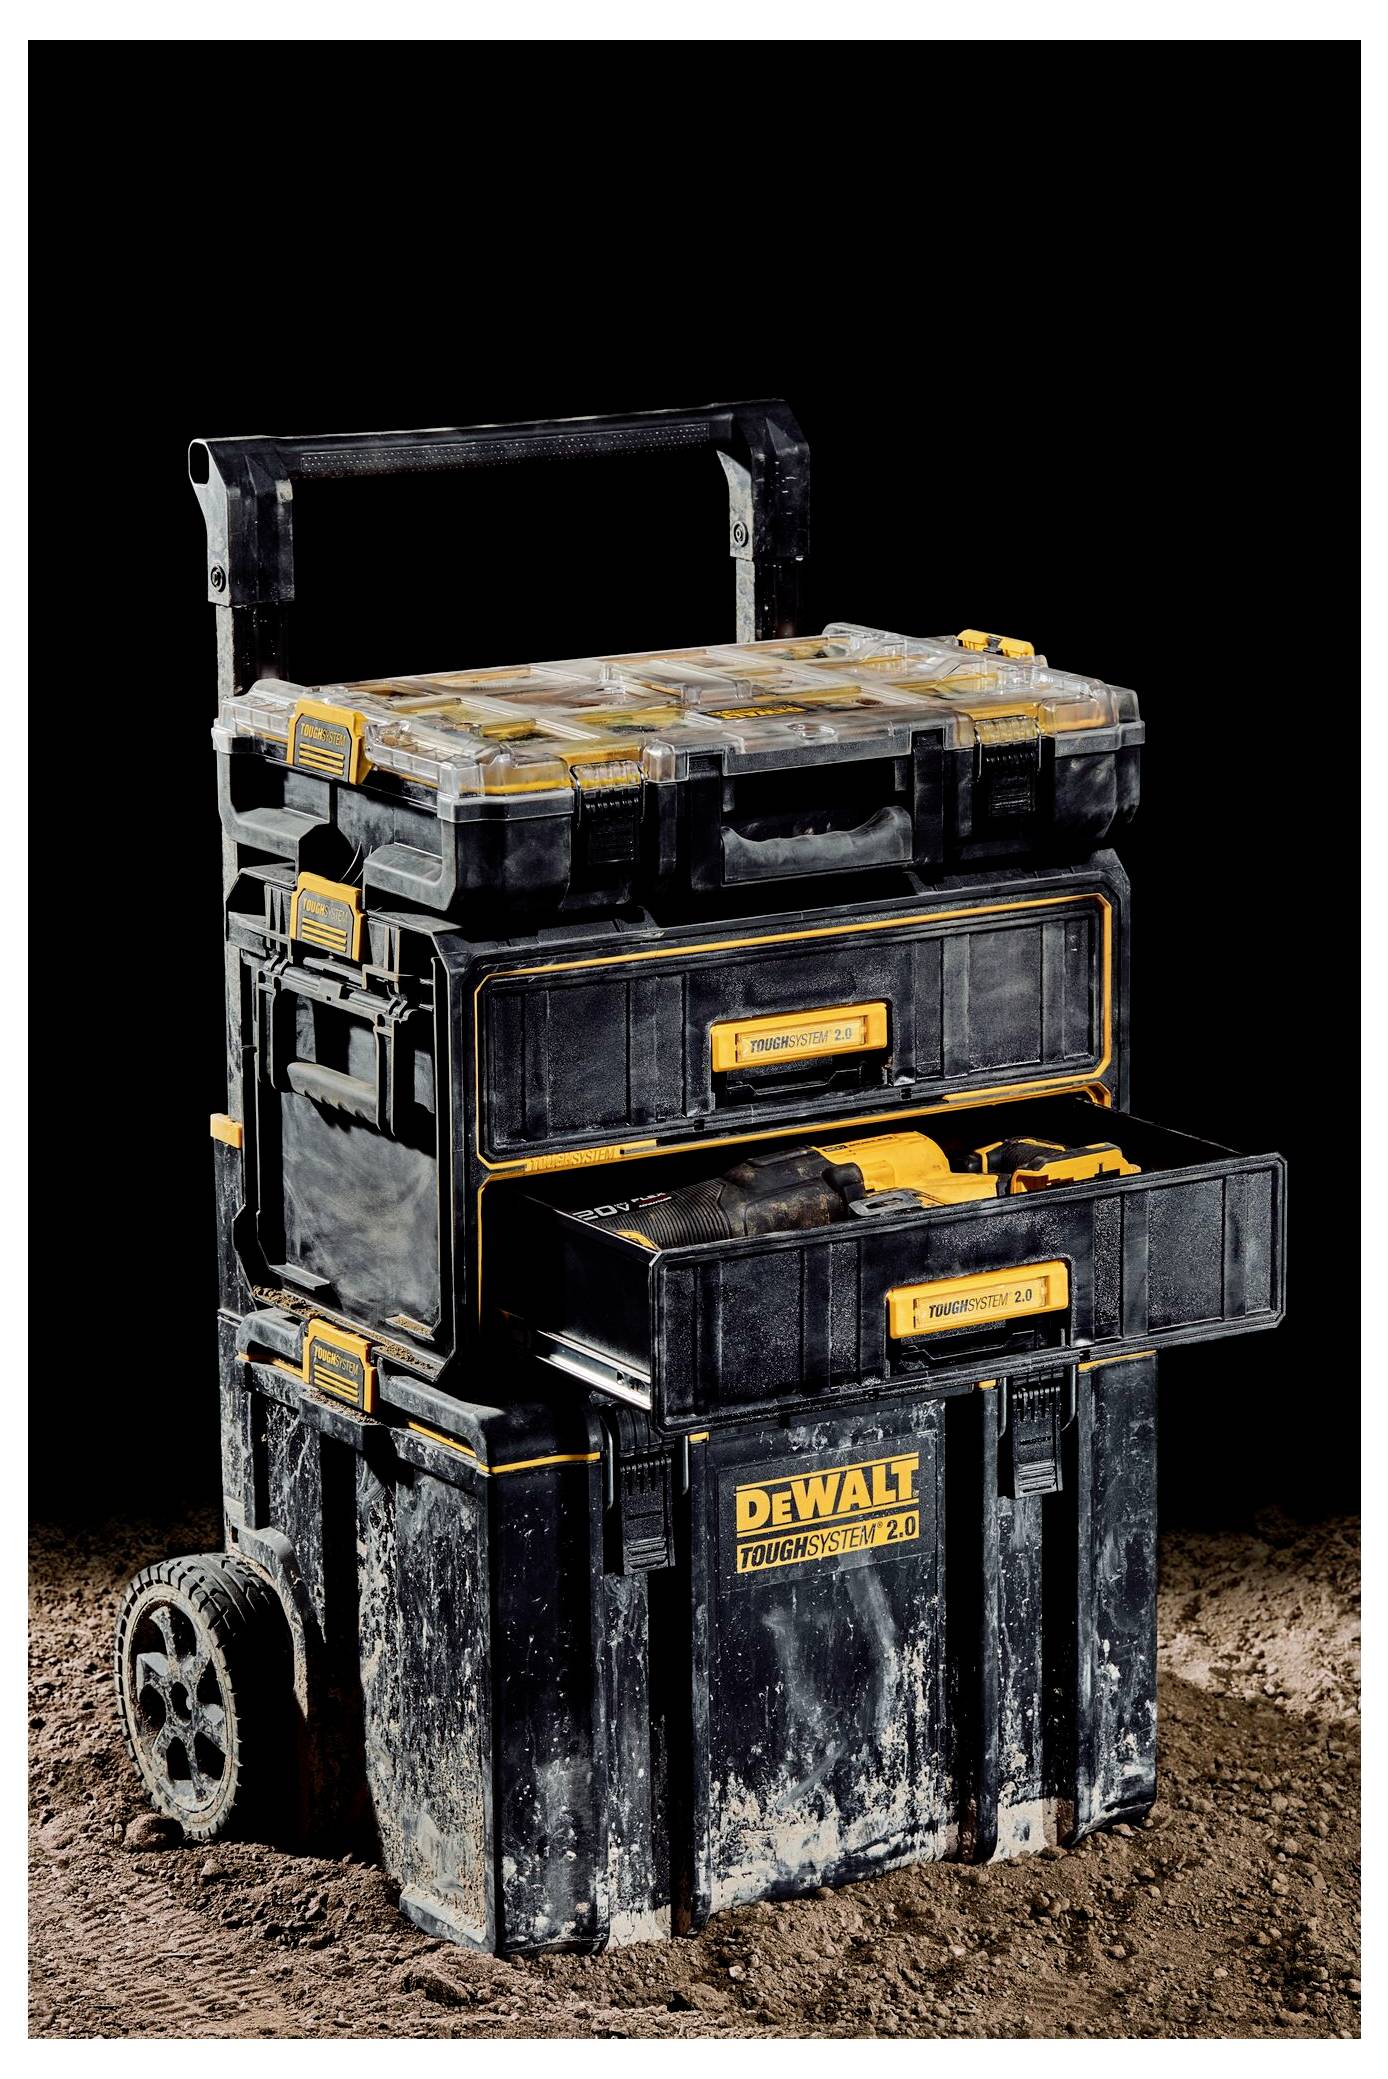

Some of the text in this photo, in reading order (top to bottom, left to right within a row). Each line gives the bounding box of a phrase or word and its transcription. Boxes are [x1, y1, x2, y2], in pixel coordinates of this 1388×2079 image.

[300, 722, 347, 748] TOUGHSYSTEM
[750, 1027, 852, 1054] TOUGHSYSTEM 2.0
[928, 1288, 1033, 1319] TOUGHSYSTEM 2.0
[313, 1344, 359, 1376] TOUGHSYSTEM
[886, 1515, 917, 1541] 2.0
